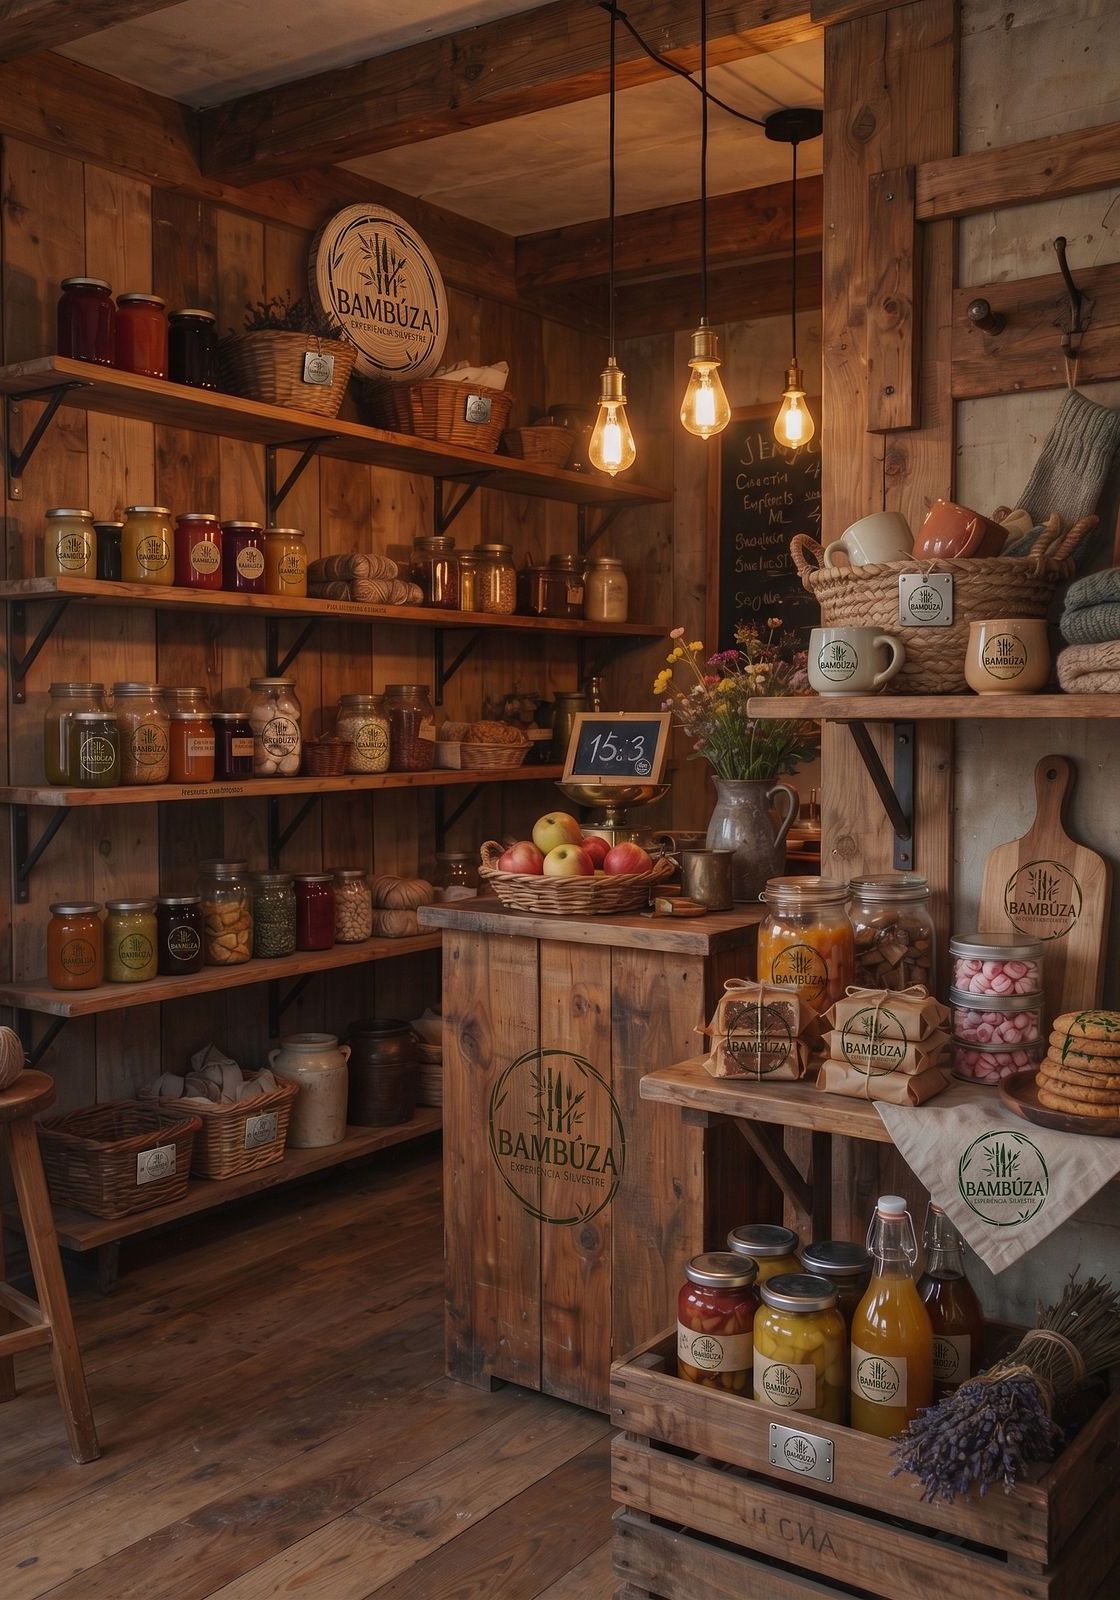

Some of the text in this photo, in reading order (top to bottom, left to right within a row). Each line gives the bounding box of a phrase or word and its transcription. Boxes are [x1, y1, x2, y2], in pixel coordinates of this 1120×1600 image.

[336, 288, 435, 334] BAMBÚZA
[351, 320, 427, 344] EXPERIENCIA SILVESTRE
[1009, 901, 1077, 917] BAMBÚZA
[775, 974, 824, 986] BAMBÚZA
[846, 1042, 902, 1058] BAMBÚZA
[498, 1129, 618, 1177] BAMBÚZA
[511, 1161, 606, 1188] EXPERIENCIA SILVESTRE
[966, 1178, 1044, 1197] BAMBÚZA
